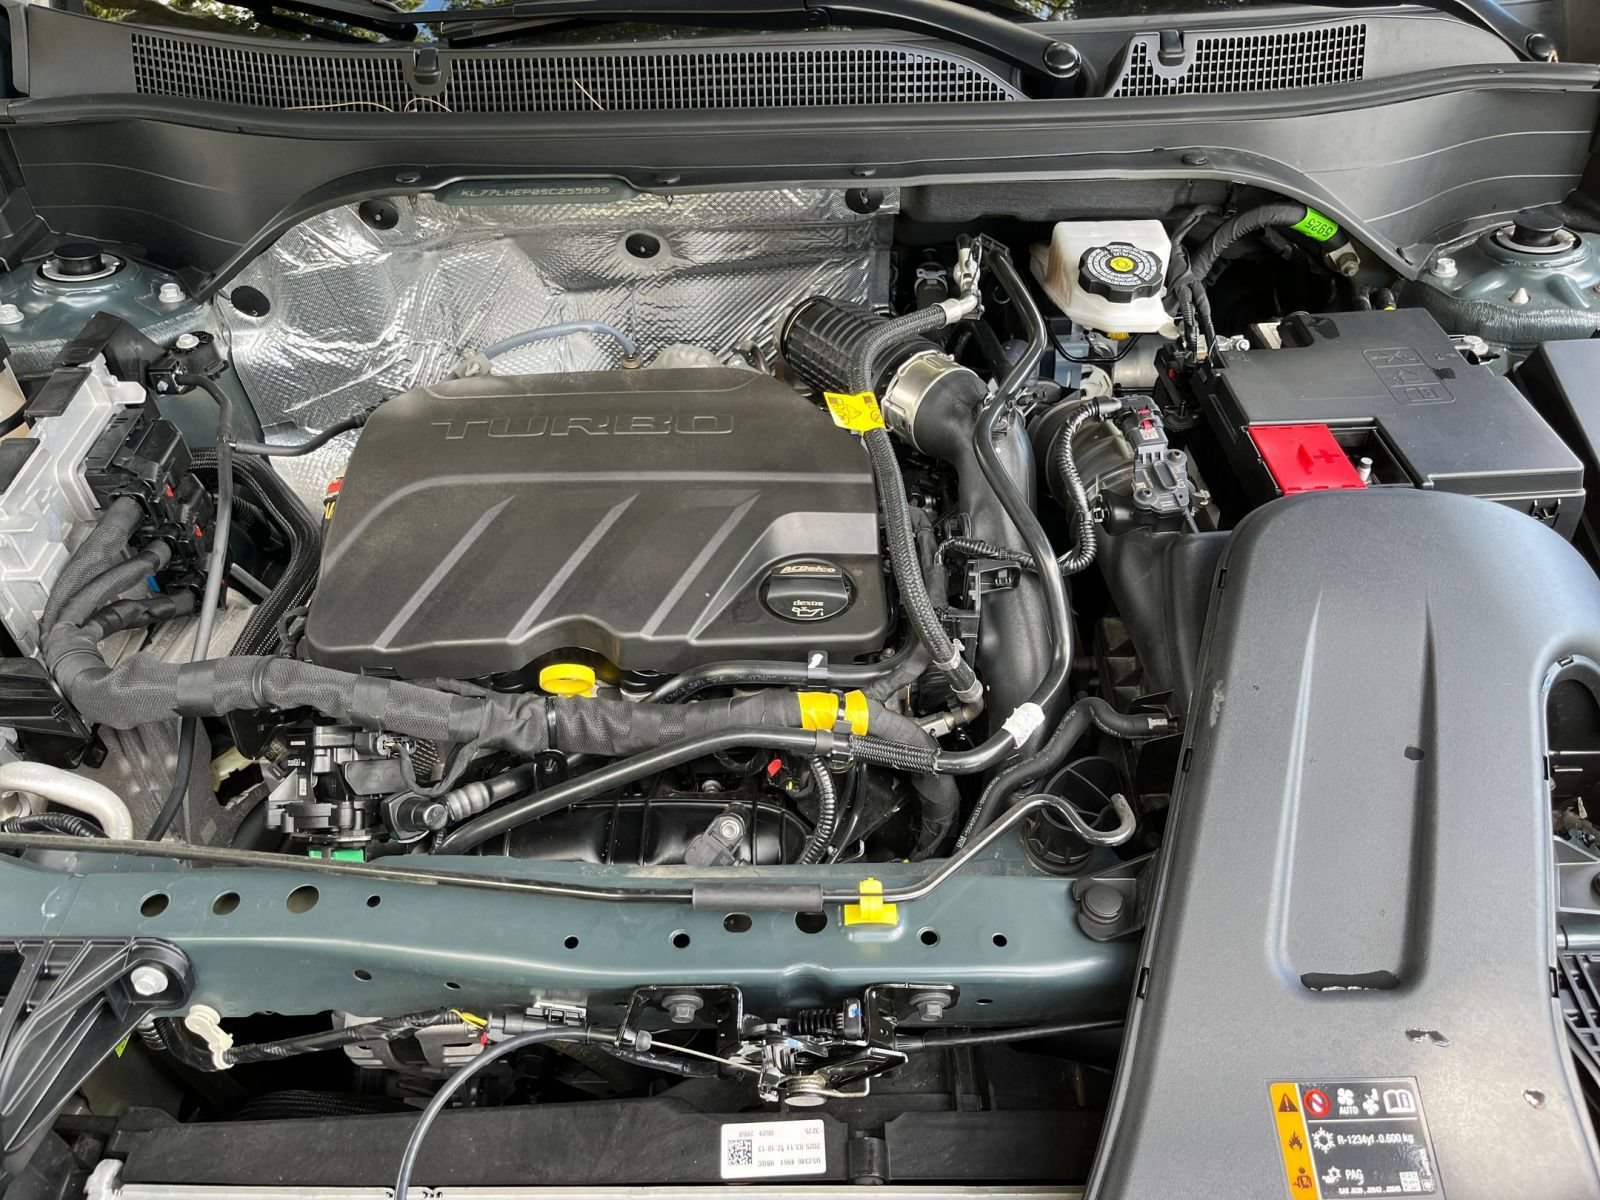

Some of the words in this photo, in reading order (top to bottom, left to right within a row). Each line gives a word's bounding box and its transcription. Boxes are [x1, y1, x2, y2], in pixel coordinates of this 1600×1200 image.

[1305, 218, 1333, 237] 5925
[431, 414, 735, 441] TURBO
[1339, 1106, 1359, 1115] AUTO
[1336, 1133, 1375, 1146] R-1234yf
[1402, 1132, 1414, 1144] kg
[1345, 1168, 1364, 1185] PAG
